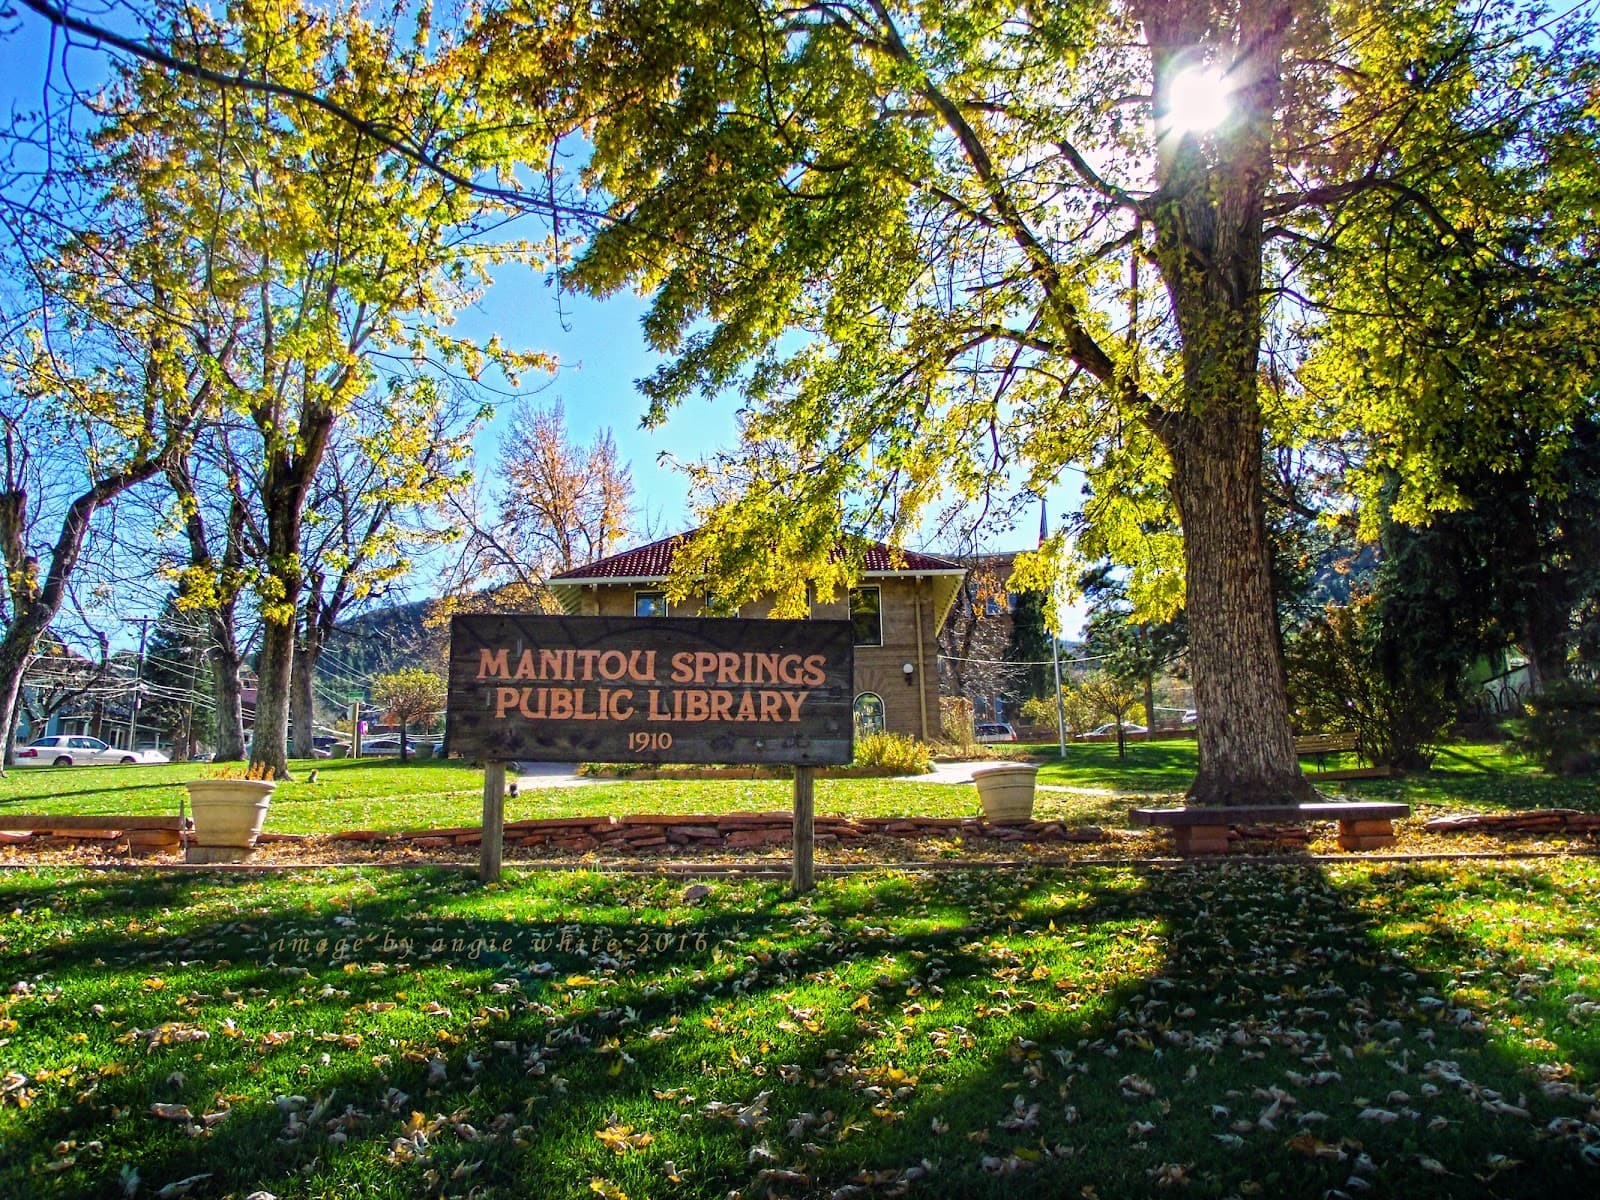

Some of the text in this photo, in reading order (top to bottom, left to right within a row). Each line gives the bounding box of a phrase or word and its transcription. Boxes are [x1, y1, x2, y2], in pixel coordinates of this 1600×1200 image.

[476, 648, 826, 686] MANITOU SPRINGS
[495, 687, 810, 722] PUBLIC LIBRARY
[628, 731, 673, 753] 1910
